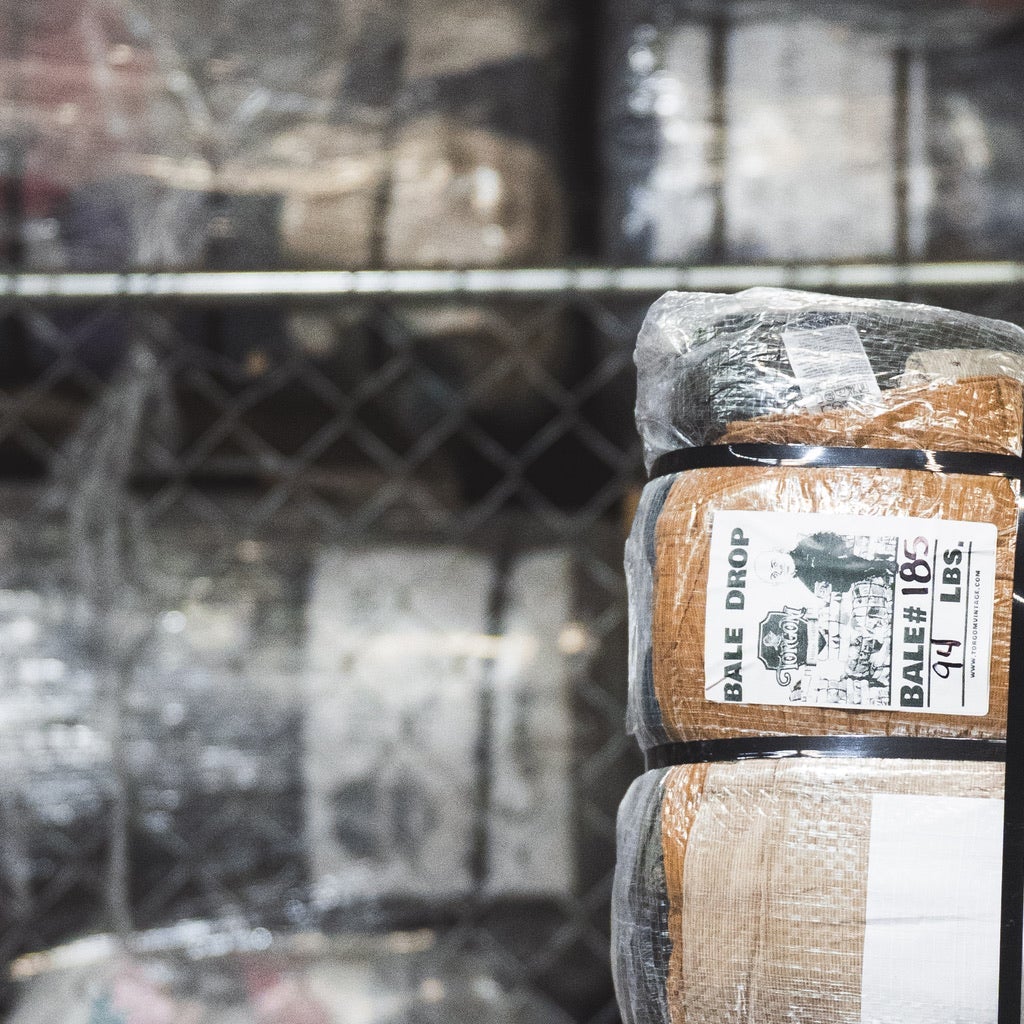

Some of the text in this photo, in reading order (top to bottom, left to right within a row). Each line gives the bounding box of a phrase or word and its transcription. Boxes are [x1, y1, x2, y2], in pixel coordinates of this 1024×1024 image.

[899, 535, 932, 596] 185
[940, 540, 965, 603] LBS.
[723, 527, 750, 702] BALE DROP
[776, 605, 808, 687] TORGOM
[930, 638, 964, 680] 94
